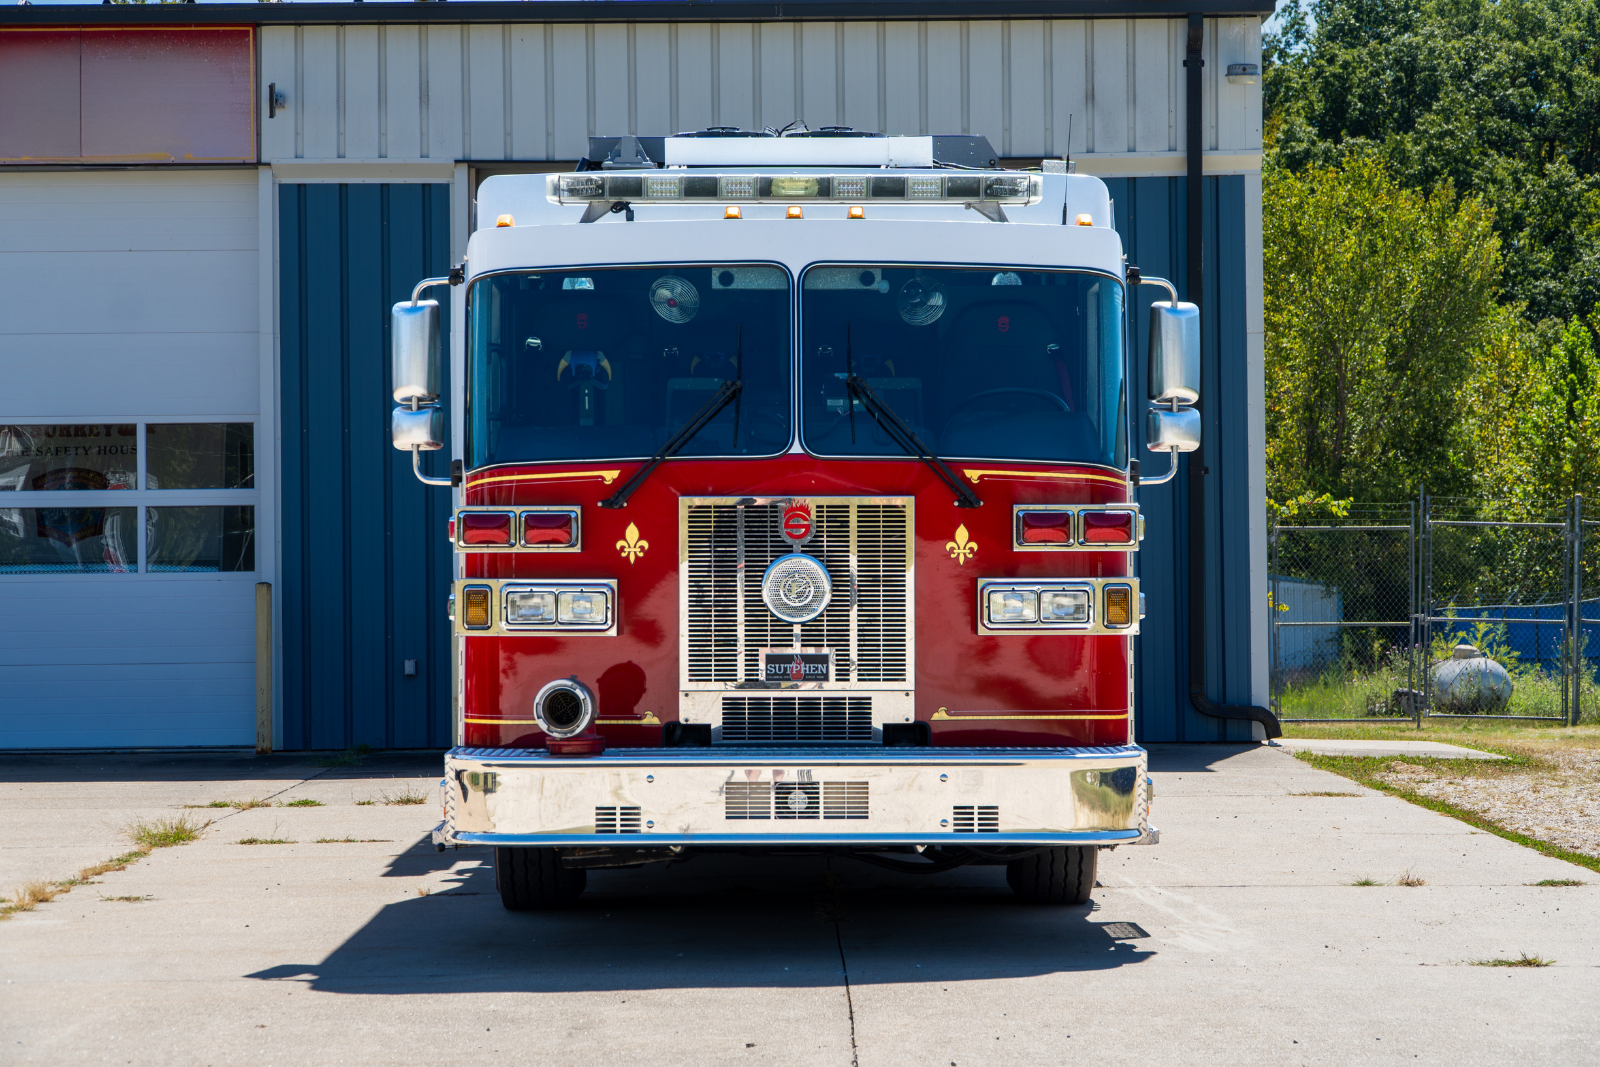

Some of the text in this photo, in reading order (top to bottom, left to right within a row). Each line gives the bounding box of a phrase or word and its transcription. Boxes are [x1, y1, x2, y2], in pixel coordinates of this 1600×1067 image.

[36, 446, 91, 456] SAFETY
[97, 445, 138, 455] HOUS
[767, 664, 827, 674] SUTPHEN
